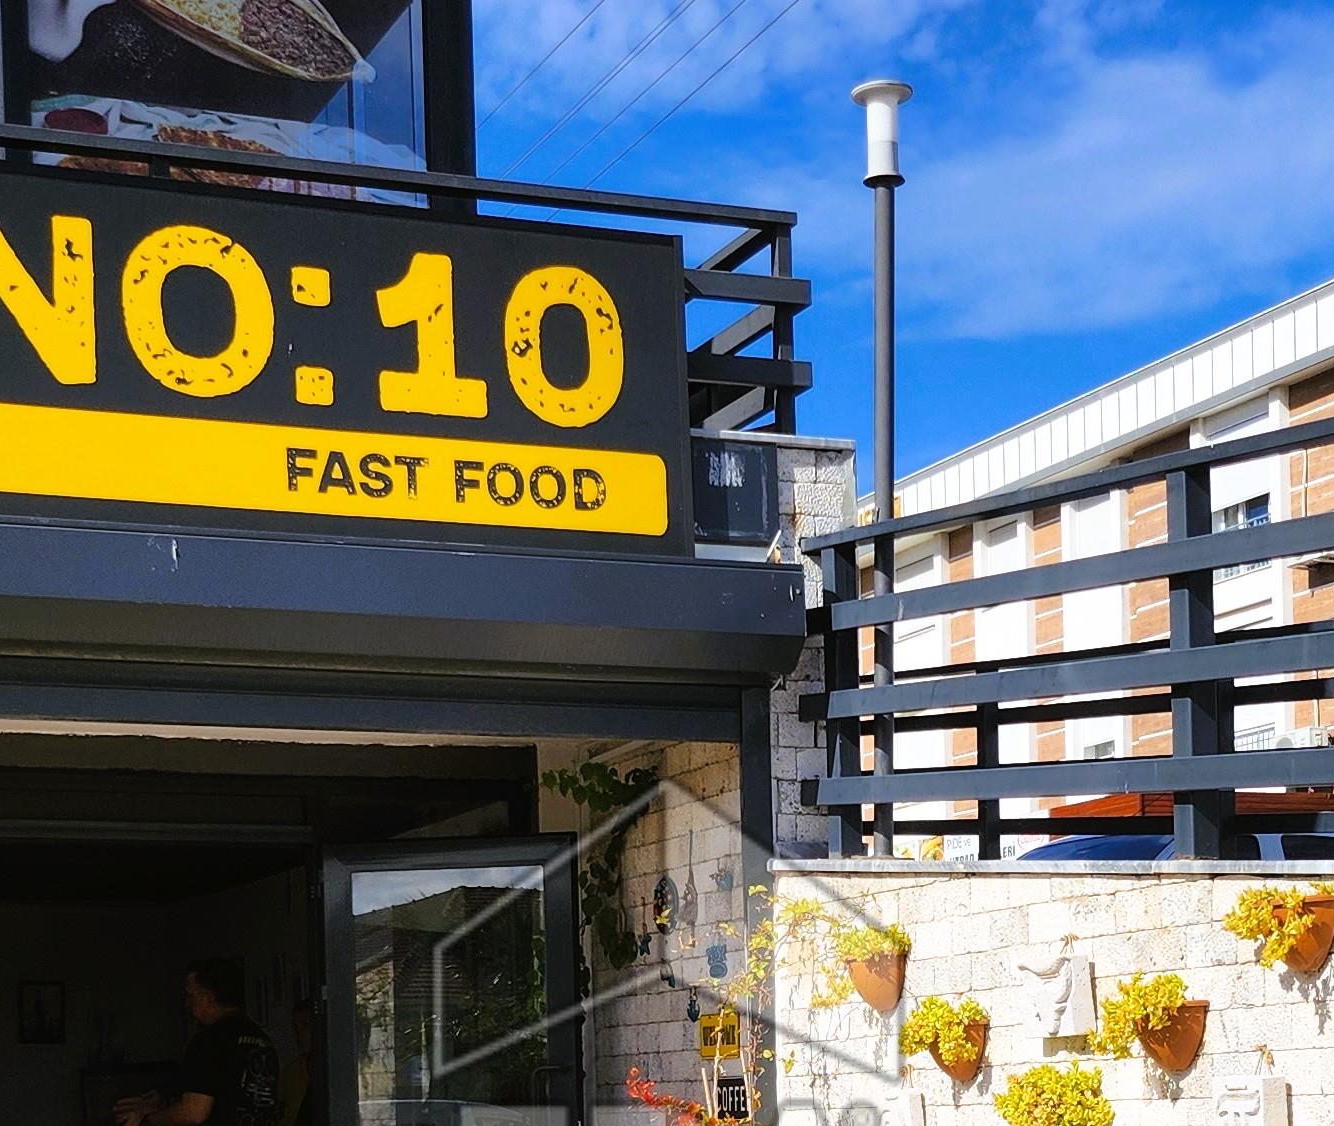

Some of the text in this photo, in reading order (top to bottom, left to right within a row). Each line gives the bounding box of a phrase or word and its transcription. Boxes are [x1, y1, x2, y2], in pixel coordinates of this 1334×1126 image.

[286, 447, 607, 511] FAST FOOD
[716, 1085, 750, 1112] COFFE
